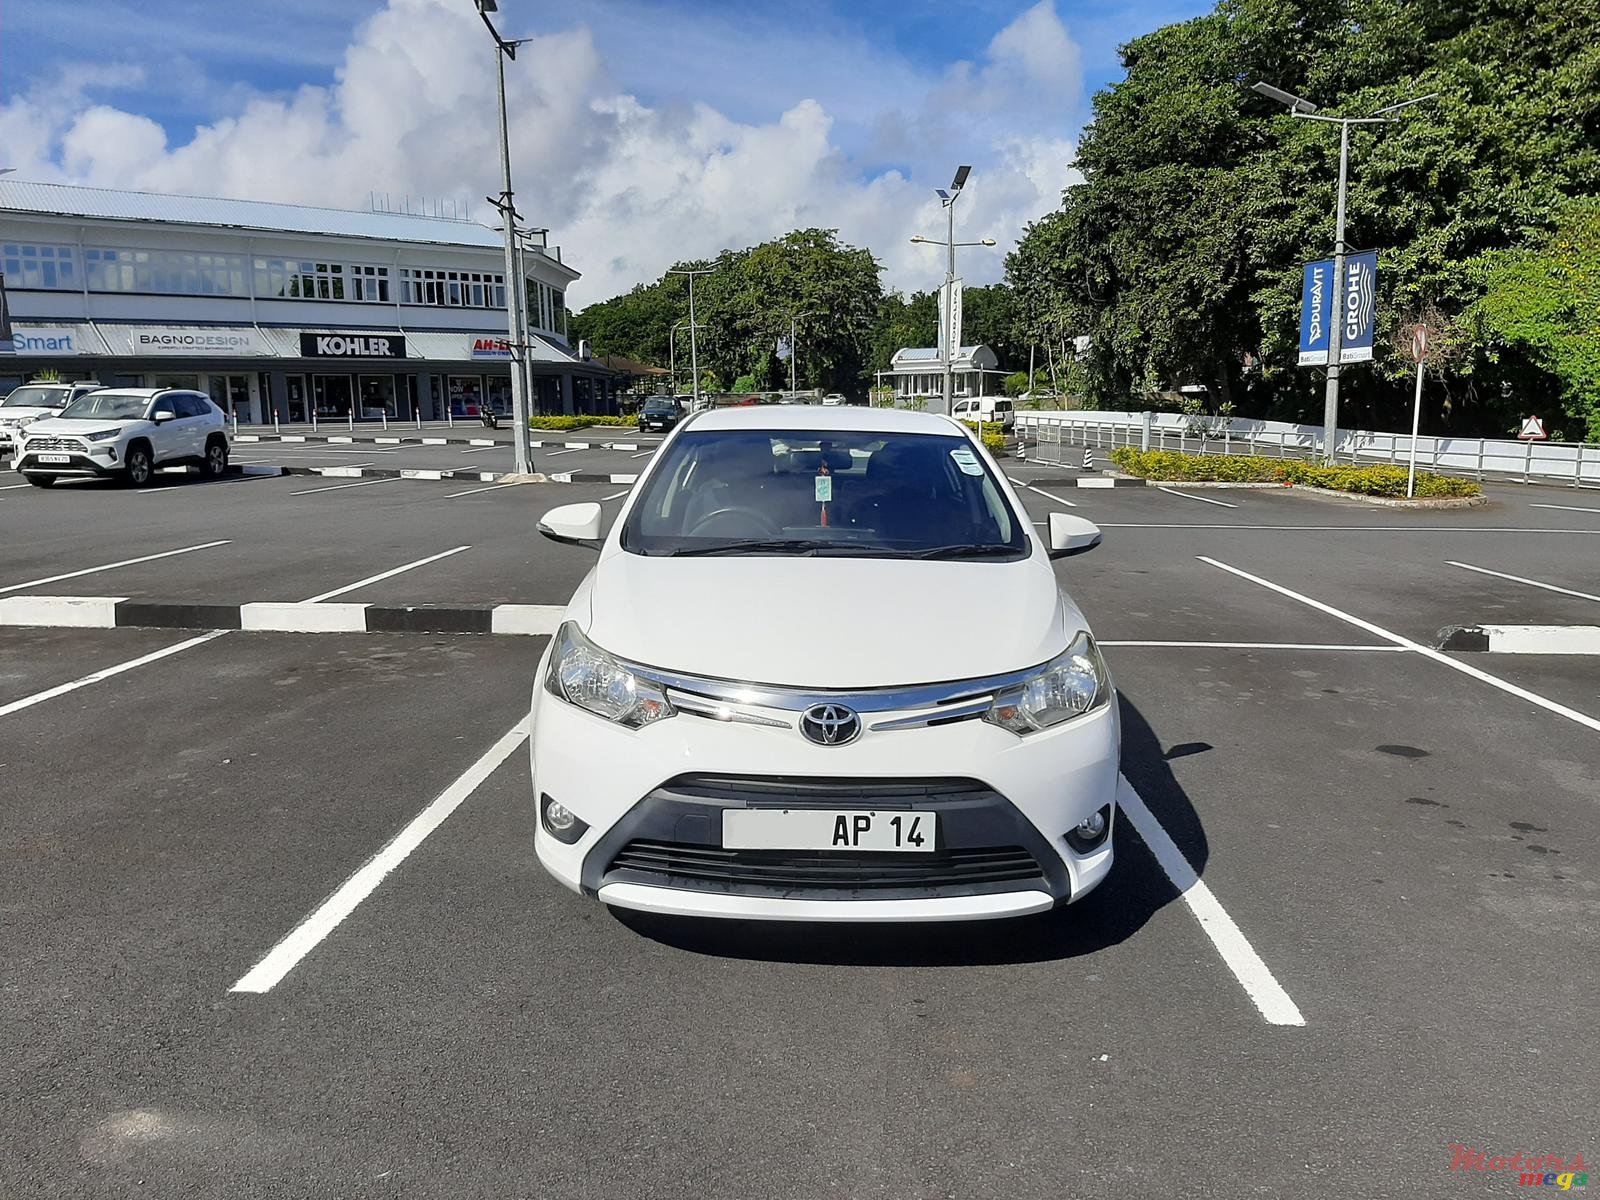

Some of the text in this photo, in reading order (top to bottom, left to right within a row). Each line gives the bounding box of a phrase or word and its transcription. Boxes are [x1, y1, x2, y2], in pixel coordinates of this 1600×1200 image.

[1310, 267, 1323, 322] DURAVIT
[1346, 262, 1360, 340] GROHE
[140, 335, 249, 346] BAGNODESIGN
[832, 815, 924, 847] AP 14
